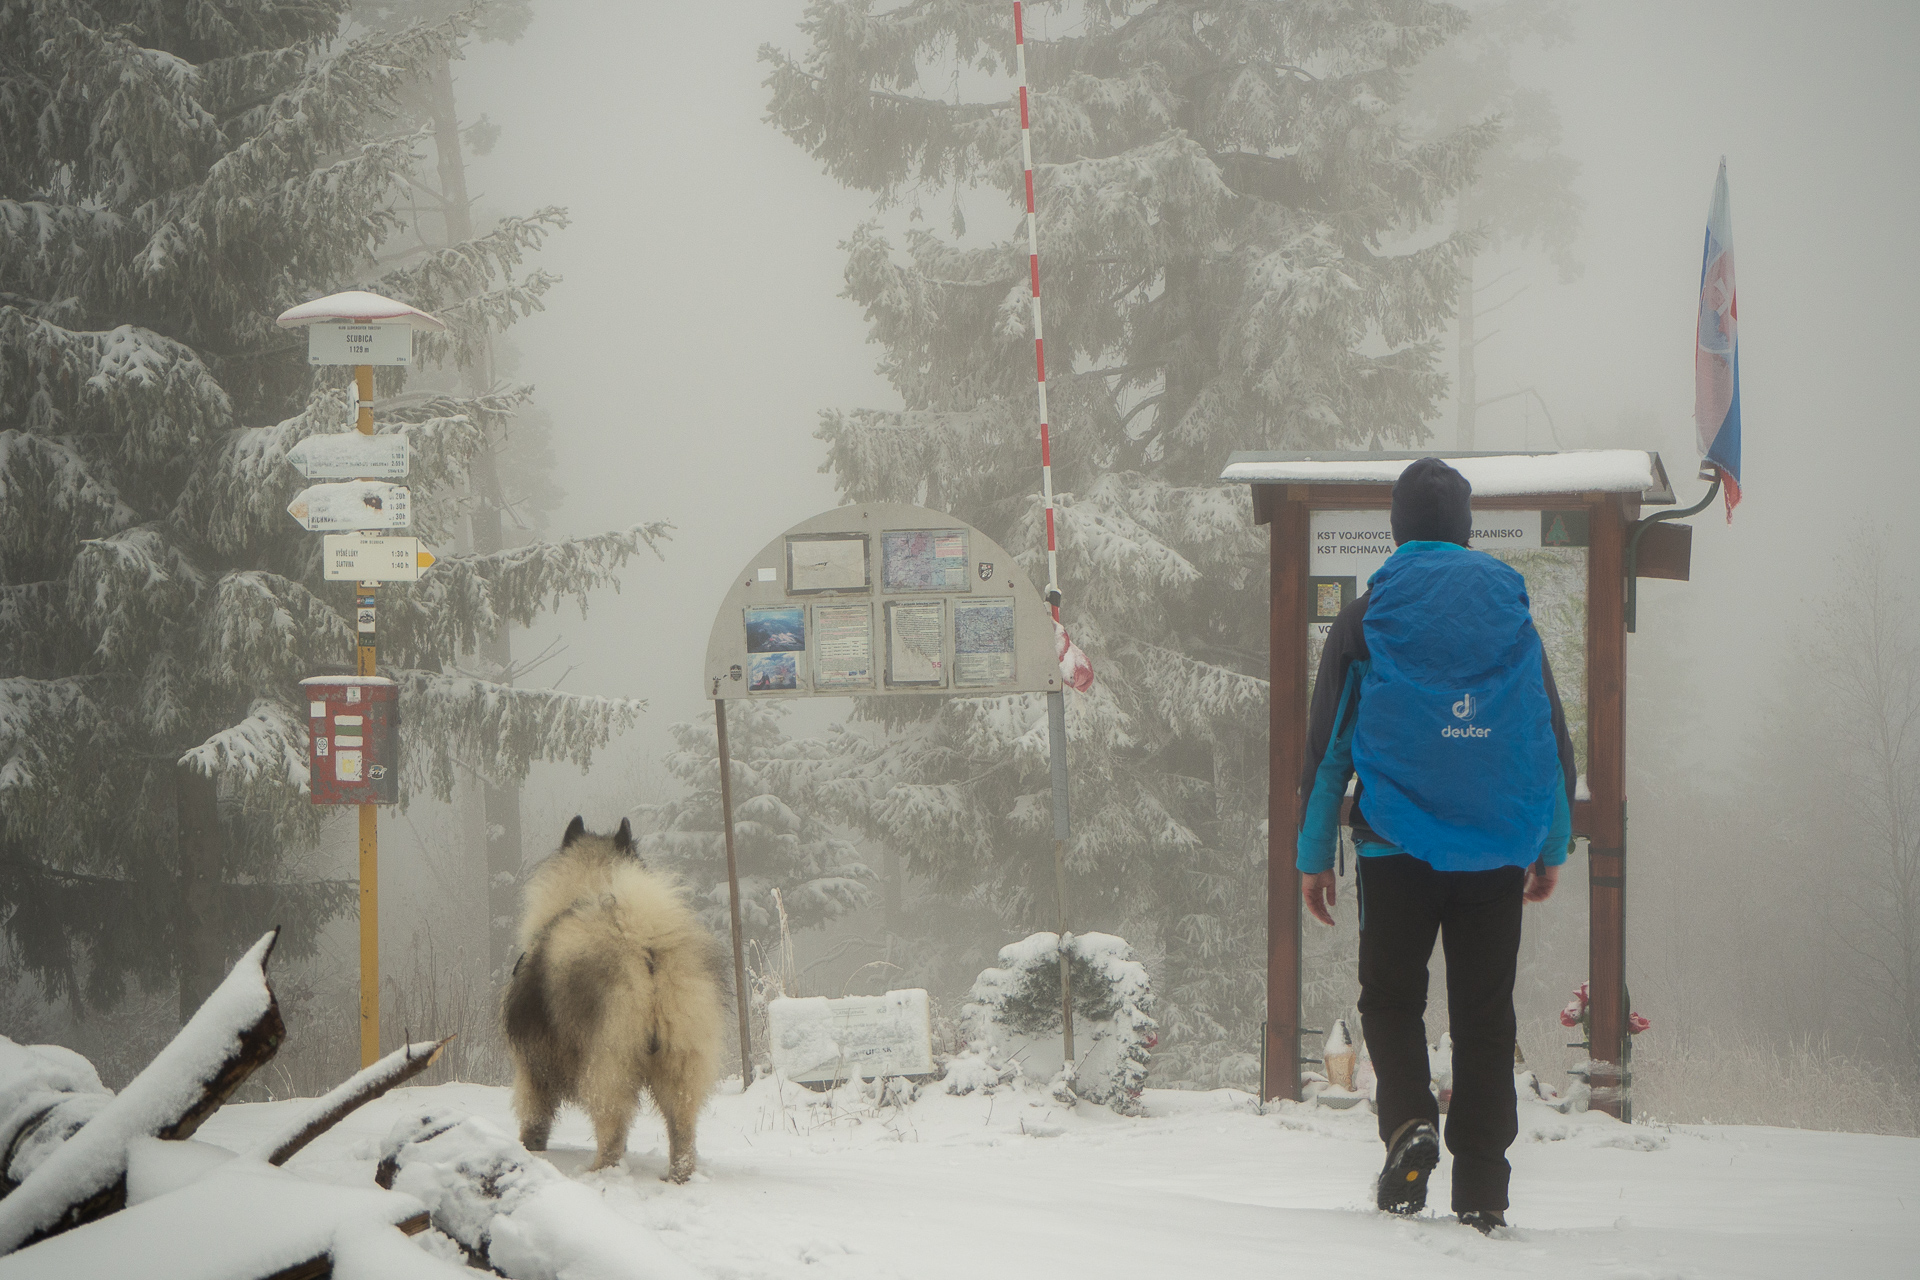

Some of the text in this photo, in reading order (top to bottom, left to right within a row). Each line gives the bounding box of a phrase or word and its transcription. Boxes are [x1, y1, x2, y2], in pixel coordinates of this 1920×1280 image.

[1317, 531, 1337, 540] KST
[1338, 531, 1391, 540] VOJKOVCE
[1317, 545, 1392, 554] KST RICHNAVA
[1441, 724, 1492, 738] deuter
